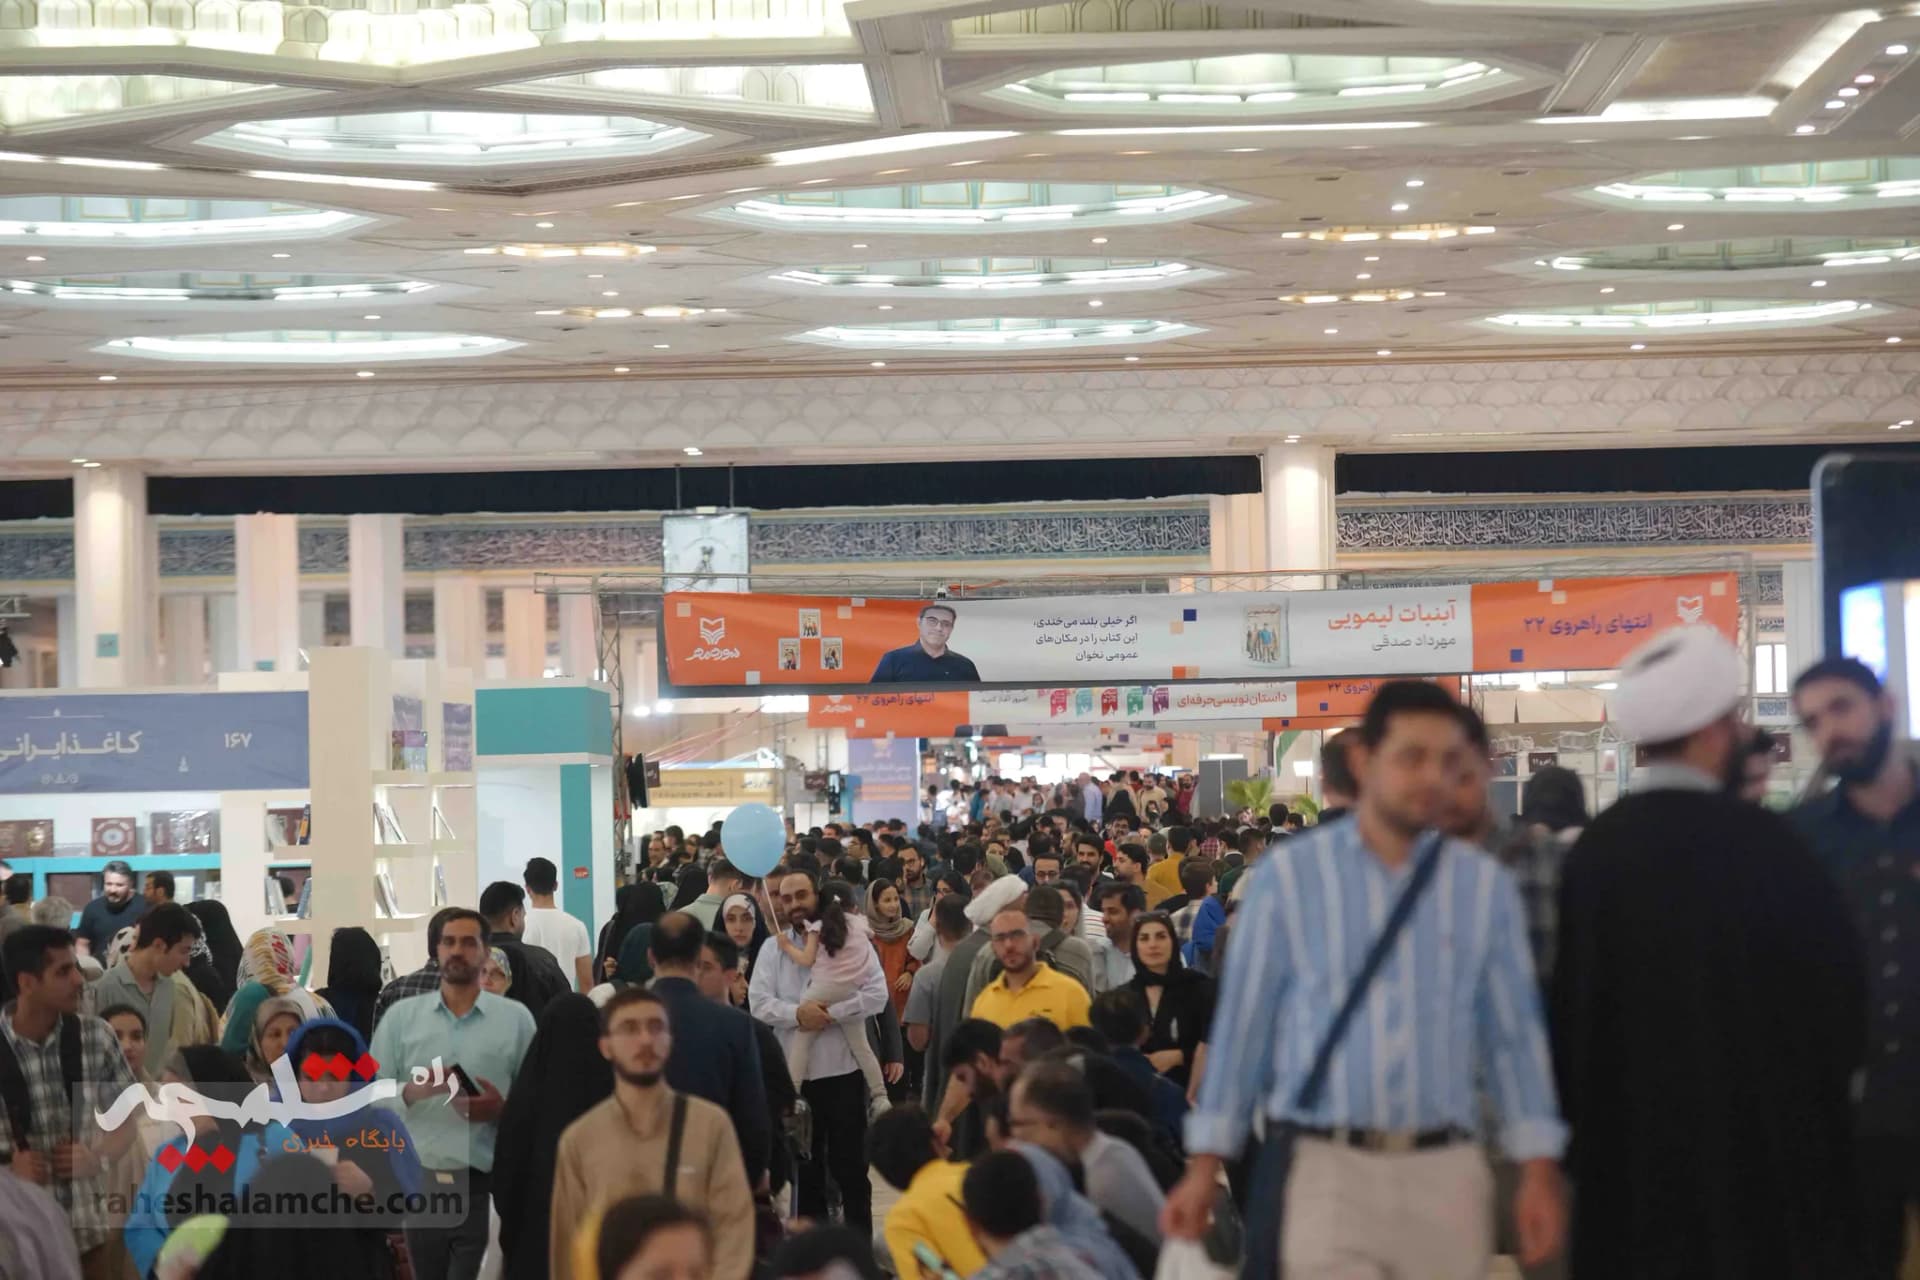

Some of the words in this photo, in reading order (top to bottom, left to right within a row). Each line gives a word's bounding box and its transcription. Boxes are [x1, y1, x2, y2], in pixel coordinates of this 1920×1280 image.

[1328, 604, 1393, 630] لیمویی
[1399, 599, 1457, 627] آبنبات
[1079, 617, 1098, 627] بلند
[1099, 616, 1123, 628] خیلی
[1124, 615, 1138, 627] اگر
[1524, 616, 1545, 632] ۲۲
[1549, 614, 1601, 635] راهروی
[1605, 612, 1653, 634] انتهای
[1079, 635, 1089, 645] در
[1090, 633, 1098, 644] را
[1099, 632, 1121, 643] کتاب
[1123, 632, 1138, 645] این
[1372, 633, 1412, 651] صدقی
[1415, 633, 1456, 650] مهرداد
[1075, 650, 1104, 661] نخوان
[1105, 651, 1139, 661] عمومی
[224, 732, 252, 749] ۱۶۷
